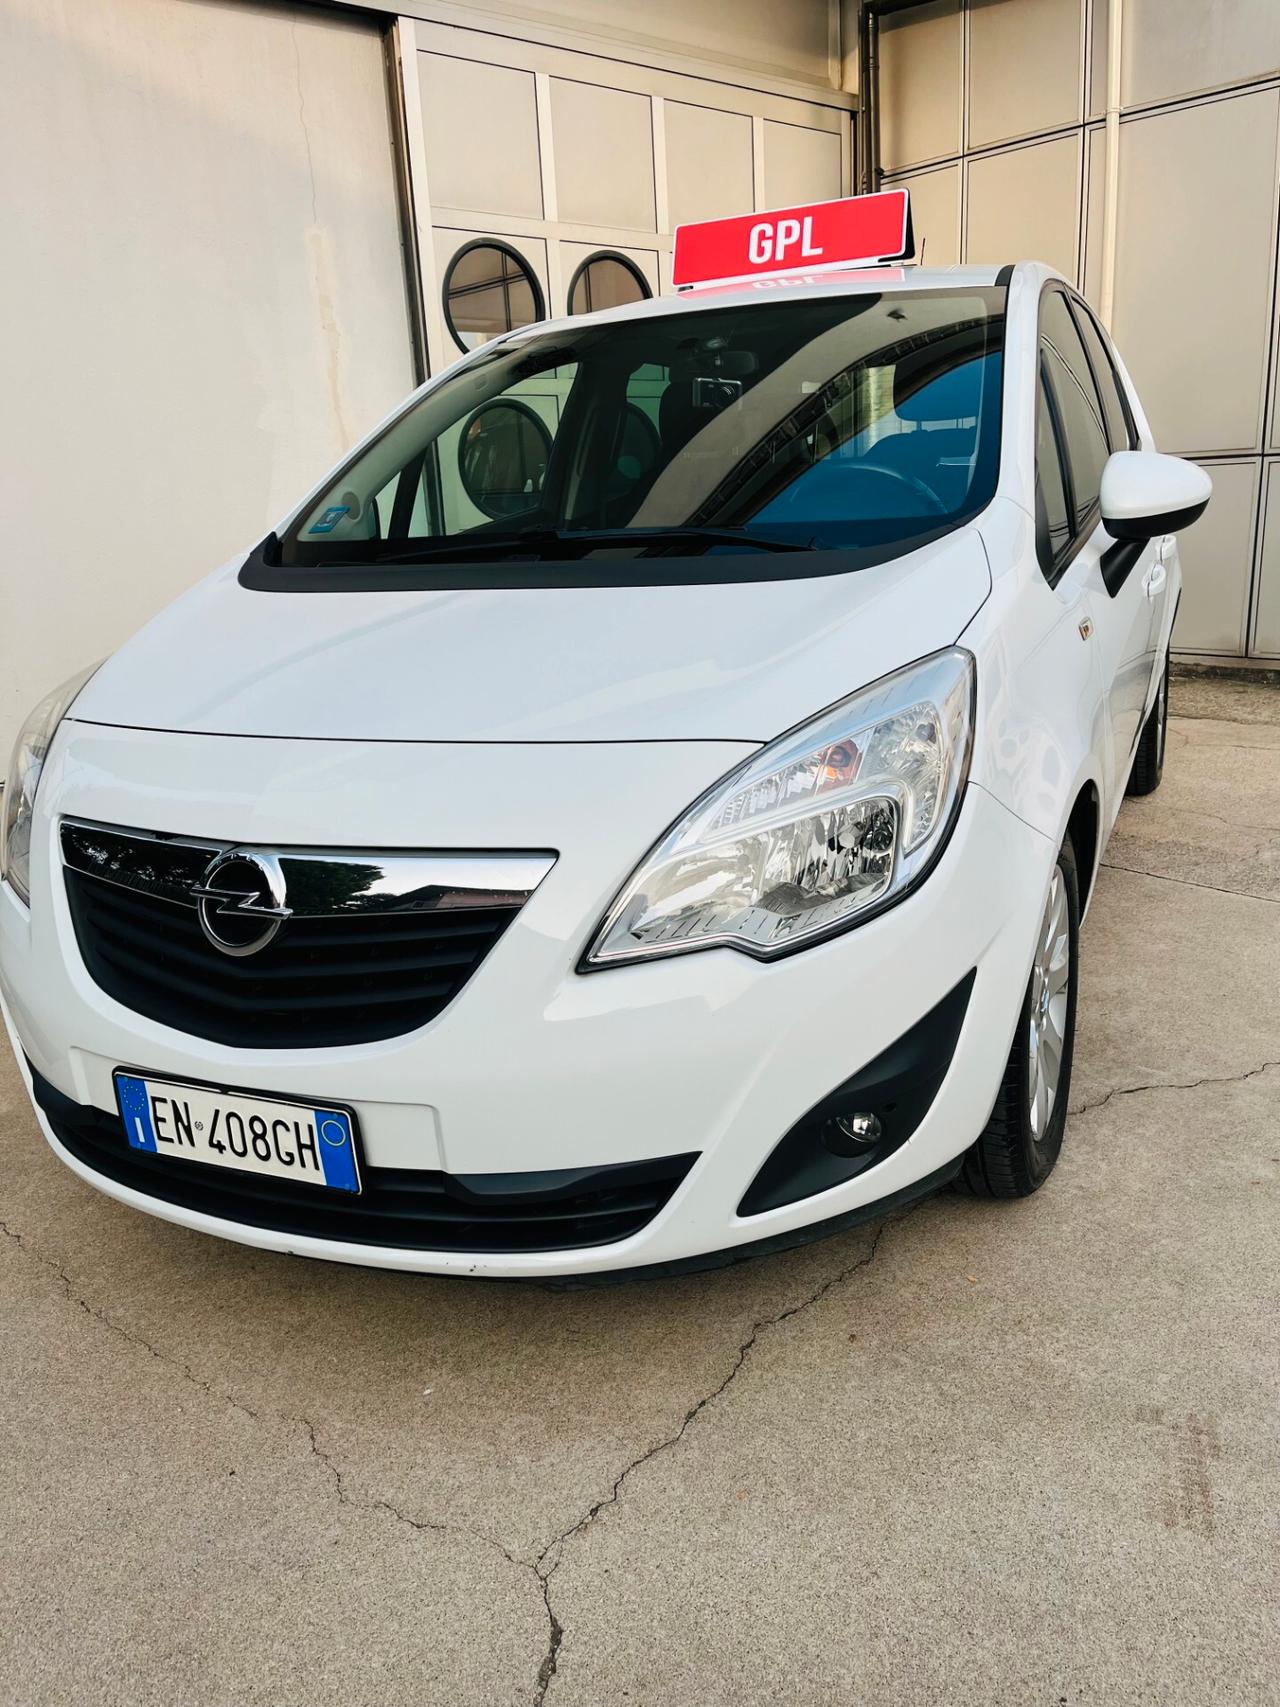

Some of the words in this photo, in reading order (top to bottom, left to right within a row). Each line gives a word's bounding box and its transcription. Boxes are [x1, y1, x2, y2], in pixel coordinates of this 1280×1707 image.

[748, 216, 823, 264] GPL
[150, 1095, 195, 1147] EN
[208, 1109, 320, 1171] 408GH
